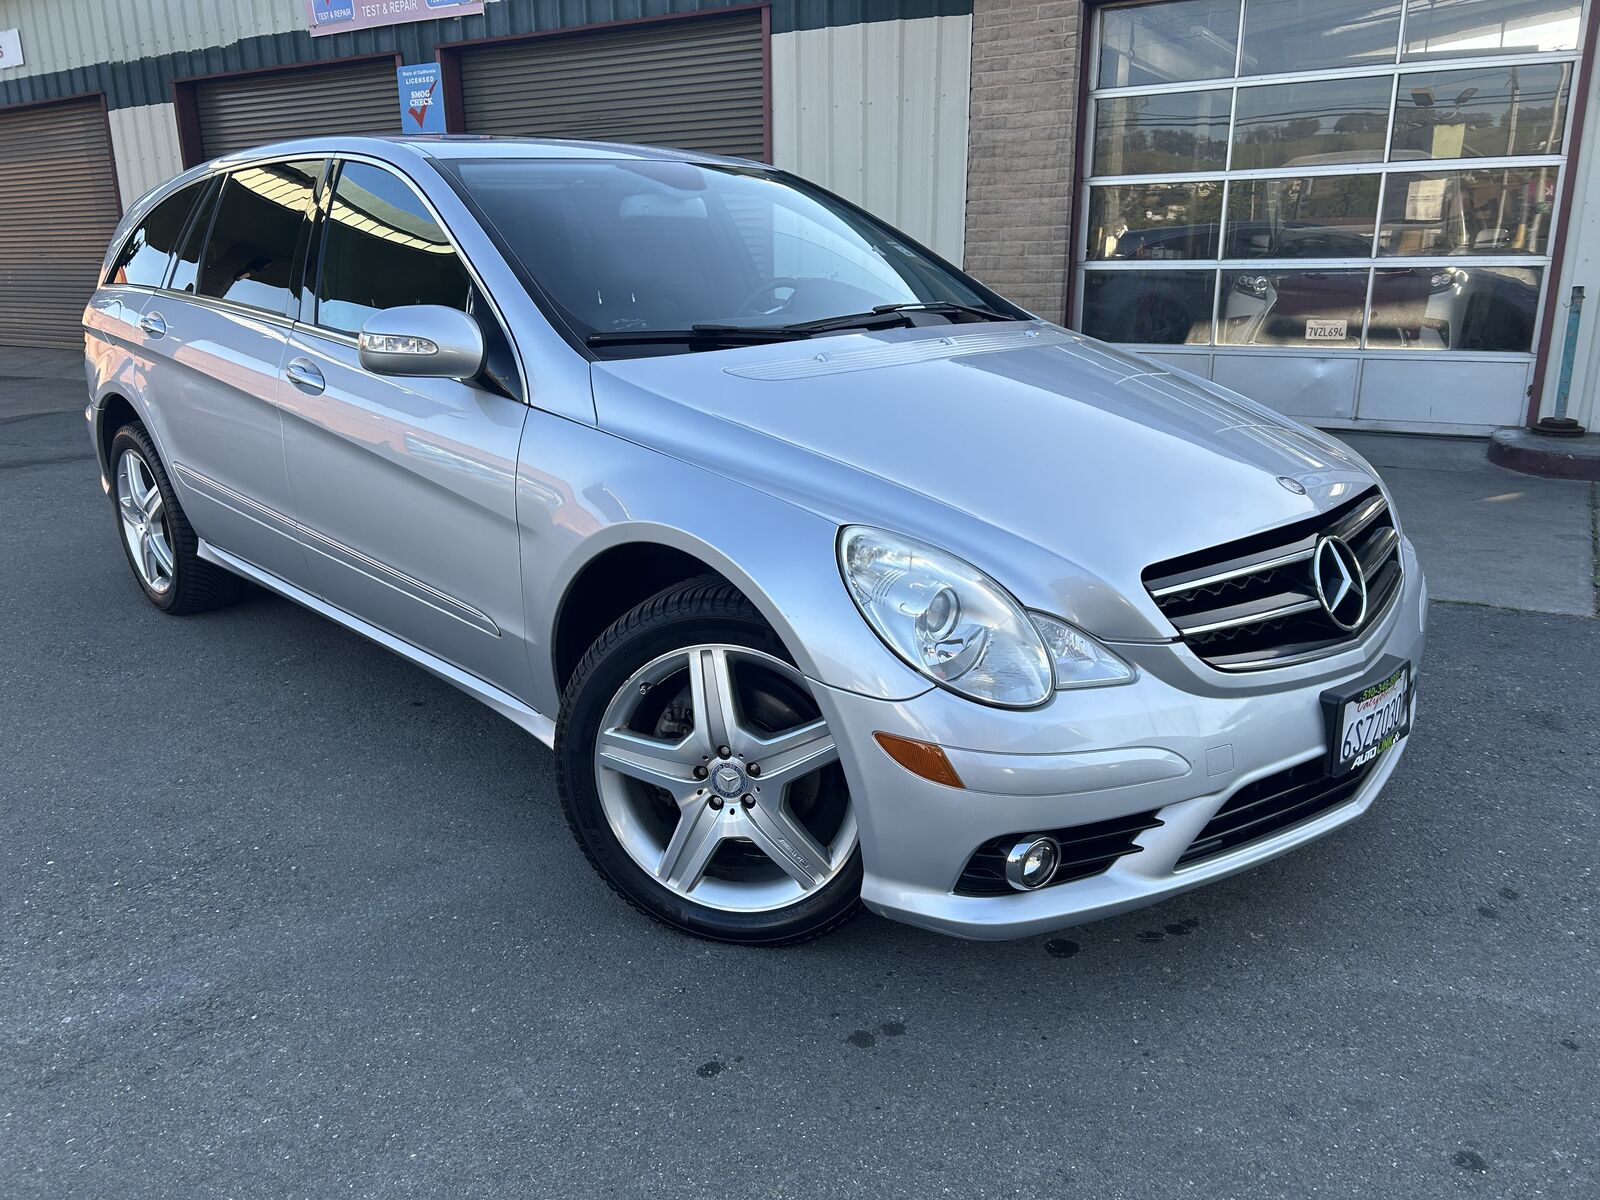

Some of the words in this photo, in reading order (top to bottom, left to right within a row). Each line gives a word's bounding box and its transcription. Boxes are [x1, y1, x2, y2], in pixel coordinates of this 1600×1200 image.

[361, 4, 380, 17] TEST
[382, 3, 388, 14] &
[389, 0, 418, 13] REPAIR
[318, 12, 330, 20] TEST
[334, 8, 352, 17] REPAIR
[405, 76, 434, 85] LICENSED
[410, 89, 431, 99] SMOG
[409, 98, 434, 107] CHECK
[1308, 327, 1344, 337] 7VZL694
[1342, 692, 1402, 760] 6SZZ030
